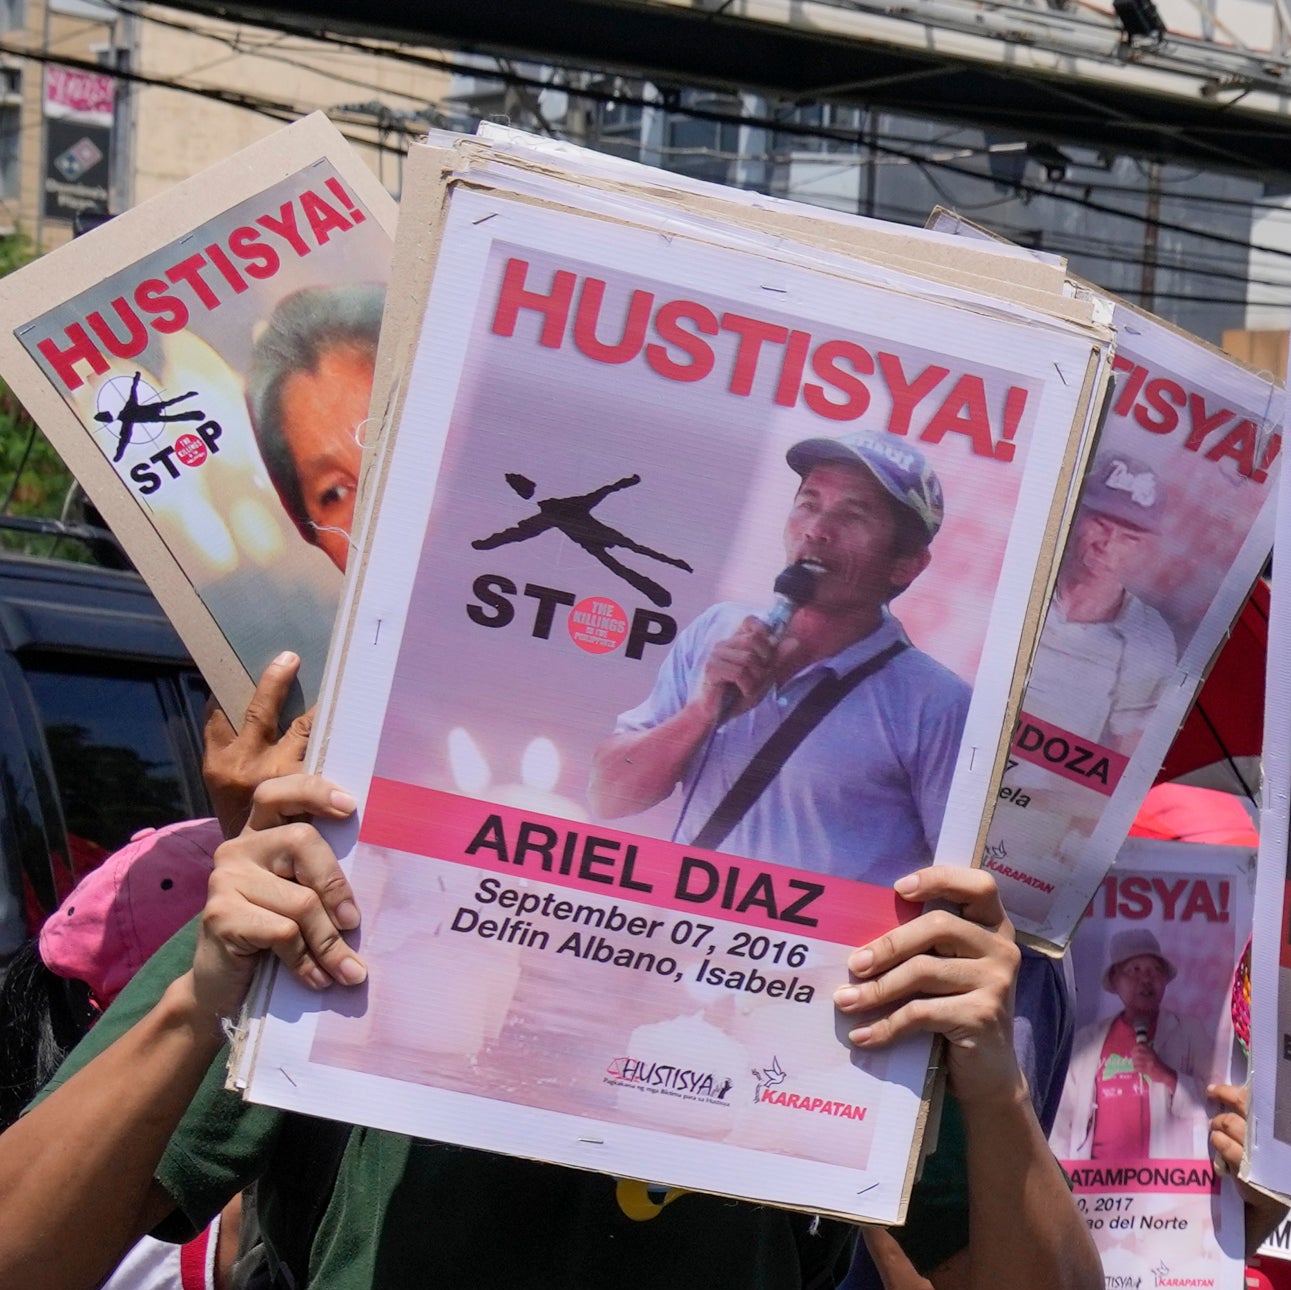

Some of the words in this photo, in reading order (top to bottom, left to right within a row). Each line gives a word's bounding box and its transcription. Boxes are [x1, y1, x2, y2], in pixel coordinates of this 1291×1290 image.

[36, 177, 367, 391] HUSTISYA!
[491, 257, 1029, 462] HUSTISYA!
[1111, 353, 1282, 485] ISYA!
[1014, 719, 1110, 786] DOZA
[464, 813, 656, 894] ARIEL
[674, 857, 826, 928] DIAZ
[986, 859, 1055, 894] KARAPATAN
[1083, 875, 1231, 923] ISYA!
[473, 877, 666, 939] September
[669, 918, 716, 956] 07,
[725, 930, 809, 968] 2016
[449, 906, 551, 954] Delfin
[556, 930, 684, 983] Albano,
[693, 957, 816, 1004] Isabela
[622, 1059, 714, 1096] HUSTISYA
[761, 1088, 868, 1121] KARAPATAN
[1094, 1197, 1134, 1212] 2017
[1109, 1216, 1135, 1230] del
[1139, 1216, 1188, 1230] Norte
[1158, 1278, 1214, 1287] KARAPATAN
